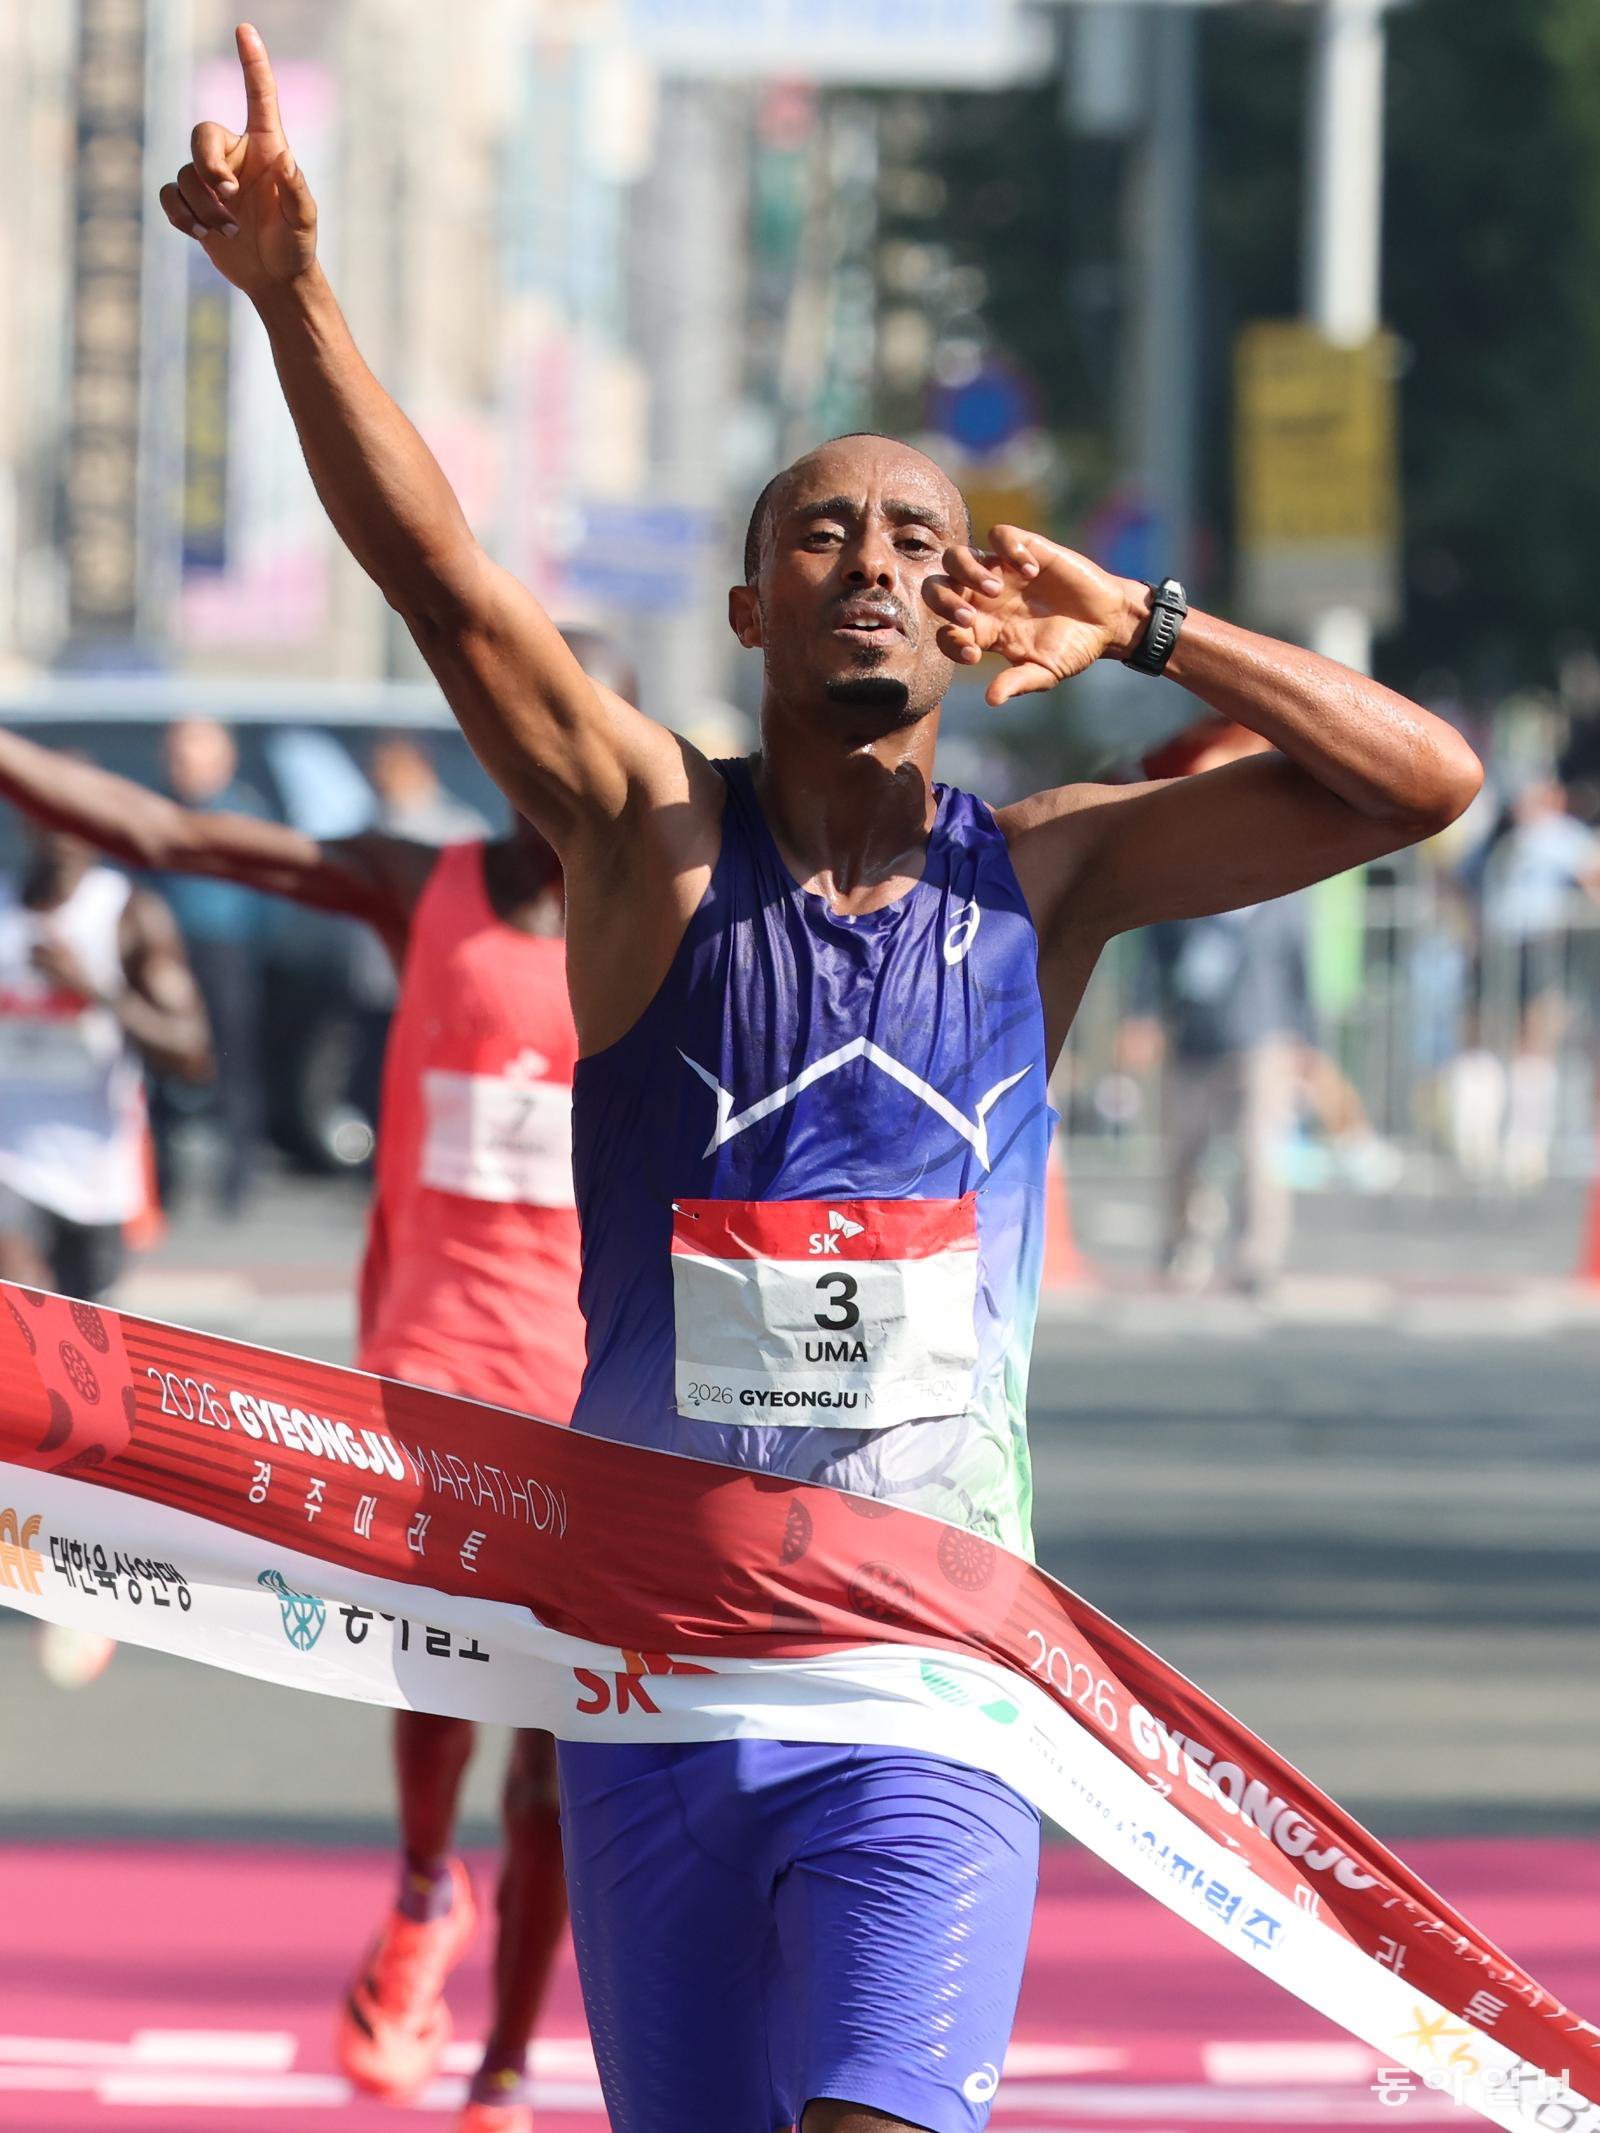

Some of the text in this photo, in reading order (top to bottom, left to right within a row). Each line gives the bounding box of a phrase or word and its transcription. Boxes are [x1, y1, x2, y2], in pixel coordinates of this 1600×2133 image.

[808, 1233, 841, 1255] SK
[814, 1271, 860, 1331] 3
[804, 1341, 868, 1363] UMA
[687, 1382, 733, 1404] 2026
[739, 1389, 858, 1409] GYEONGJU
[147, 1367, 567, 1540] 2026 GYEONGJU MARATHON
[573, 1666, 661, 1715] SK
[1026, 1629, 1119, 1732] 2026
